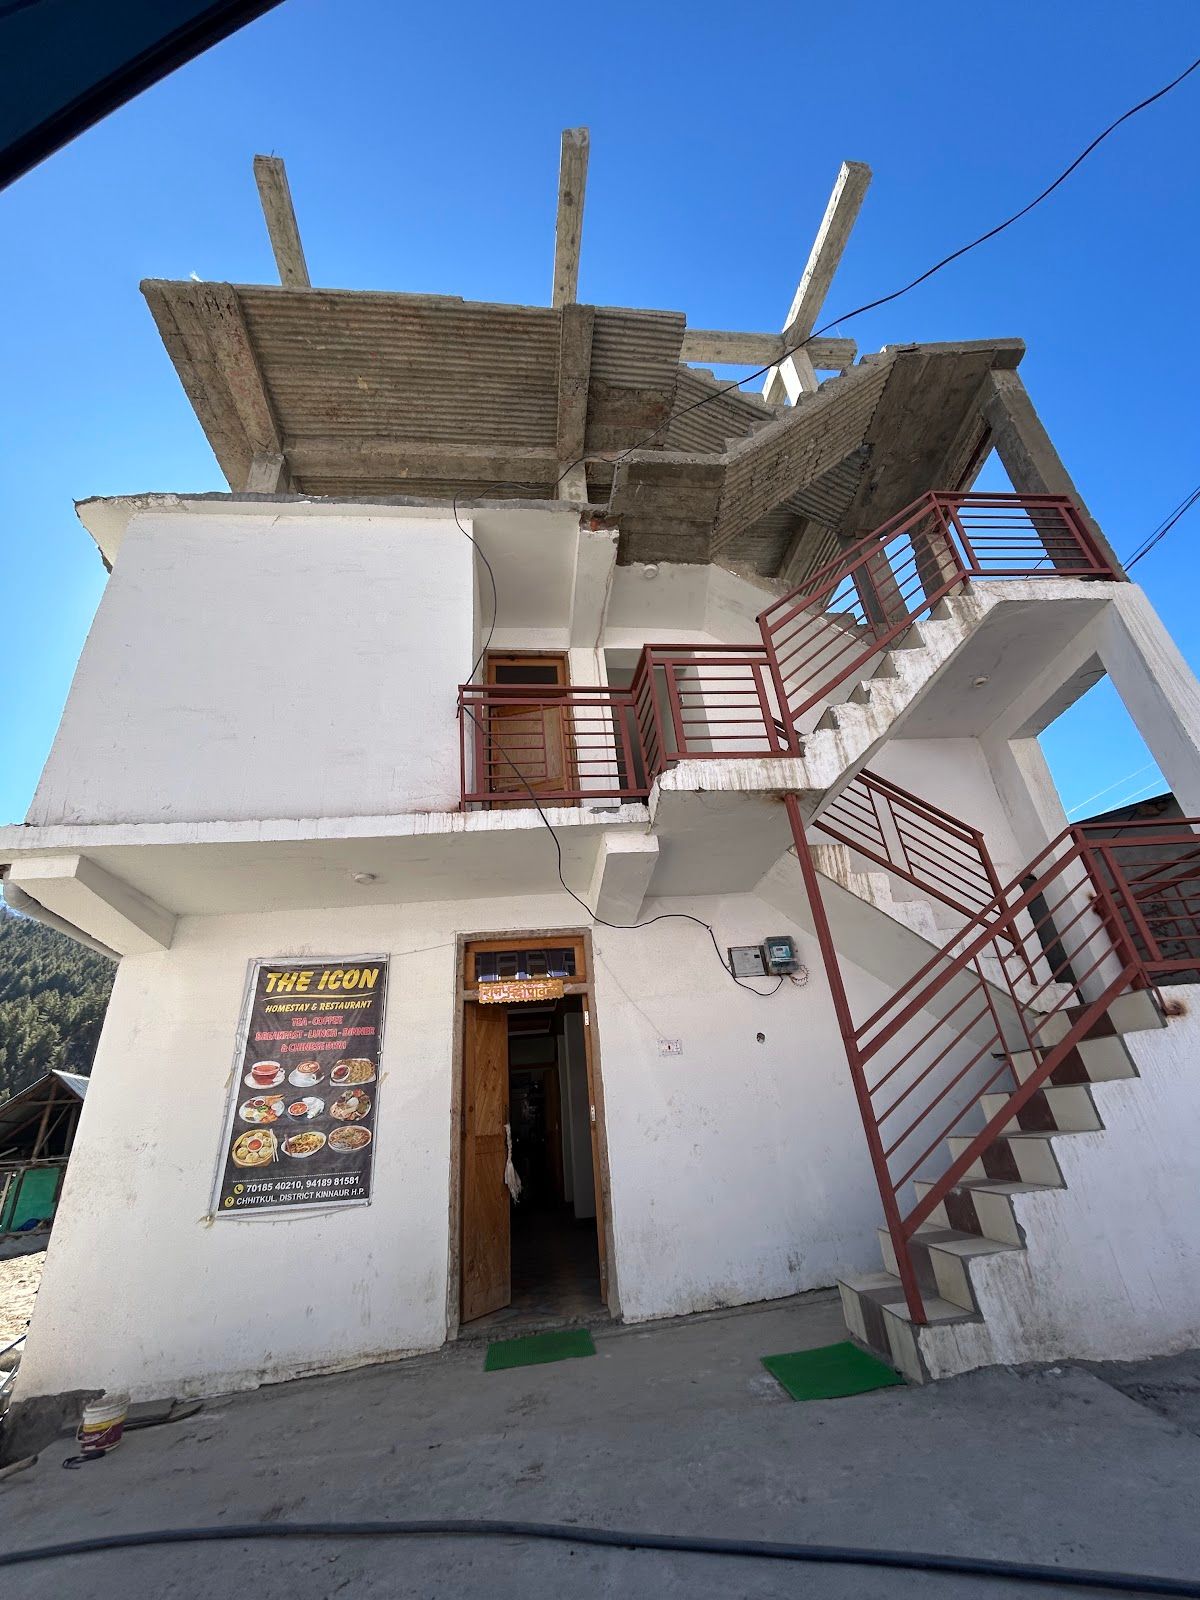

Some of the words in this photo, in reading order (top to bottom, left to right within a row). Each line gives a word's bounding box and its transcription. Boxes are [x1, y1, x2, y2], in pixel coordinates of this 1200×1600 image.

[265, 971, 314, 993] THE
[317, 968, 380, 991] ICON
[265, 1002, 309, 1013] HOMESTAY
[310, 1001, 318, 1011] &
[319, 1000, 372, 1011] RESTAURANT
[292, 1018, 308, 1026] TEA
[312, 1016, 344, 1025] COFFEE
[255, 1030, 304, 1041] BREAKFAST
[308, 1028, 338, 1038] LUNCH
[342, 1026, 376, 1036] DINNER
[288, 1042, 325, 1052] CHINESE
[246, 1183, 274, 1192] 70185
[274, 1180, 304, 1191] 40210,
[306, 1178, 332, 1188] 94189
[334, 1176, 360, 1186] 81581
[236, 1195, 278, 1205] CHHITKUL,
[280, 1191, 314, 1201] DISTRICT
[315, 1189, 350, 1199] KINNAUR
[350, 1188, 366, 1196] H.P.
